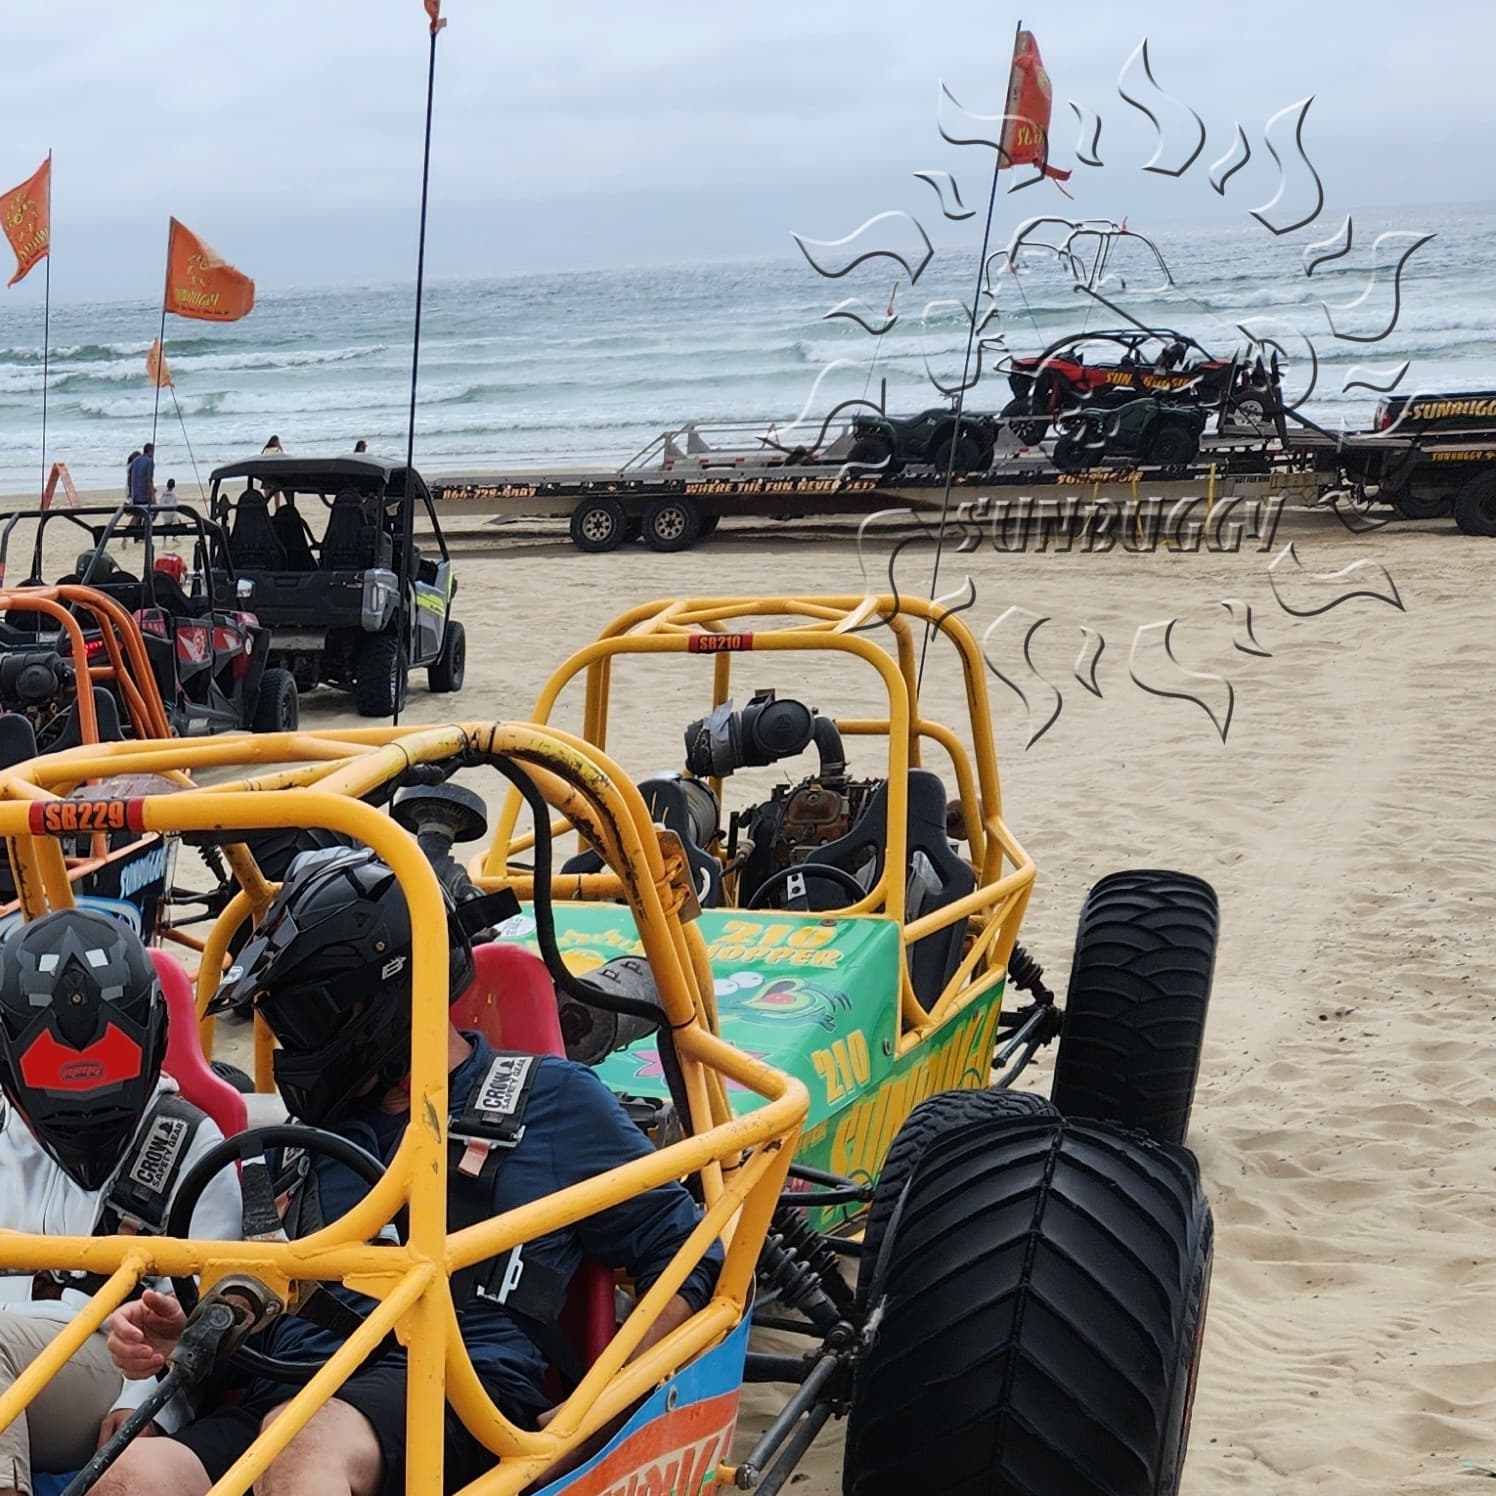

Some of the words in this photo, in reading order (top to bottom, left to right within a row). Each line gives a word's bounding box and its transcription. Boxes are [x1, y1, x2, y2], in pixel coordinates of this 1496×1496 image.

[686, 482, 733, 494] WHERE
[699, 634, 741, 650] SB210
[44, 801, 125, 831] SB229
[712, 920, 837, 949] 210
[811, 1029, 871, 1107] 210
[483, 1071, 513, 1108] CROW
[137, 1135, 169, 1184] CROW
[152, 1148, 173, 1187] SAFETY
[168, 1122, 184, 1148] GEAR
